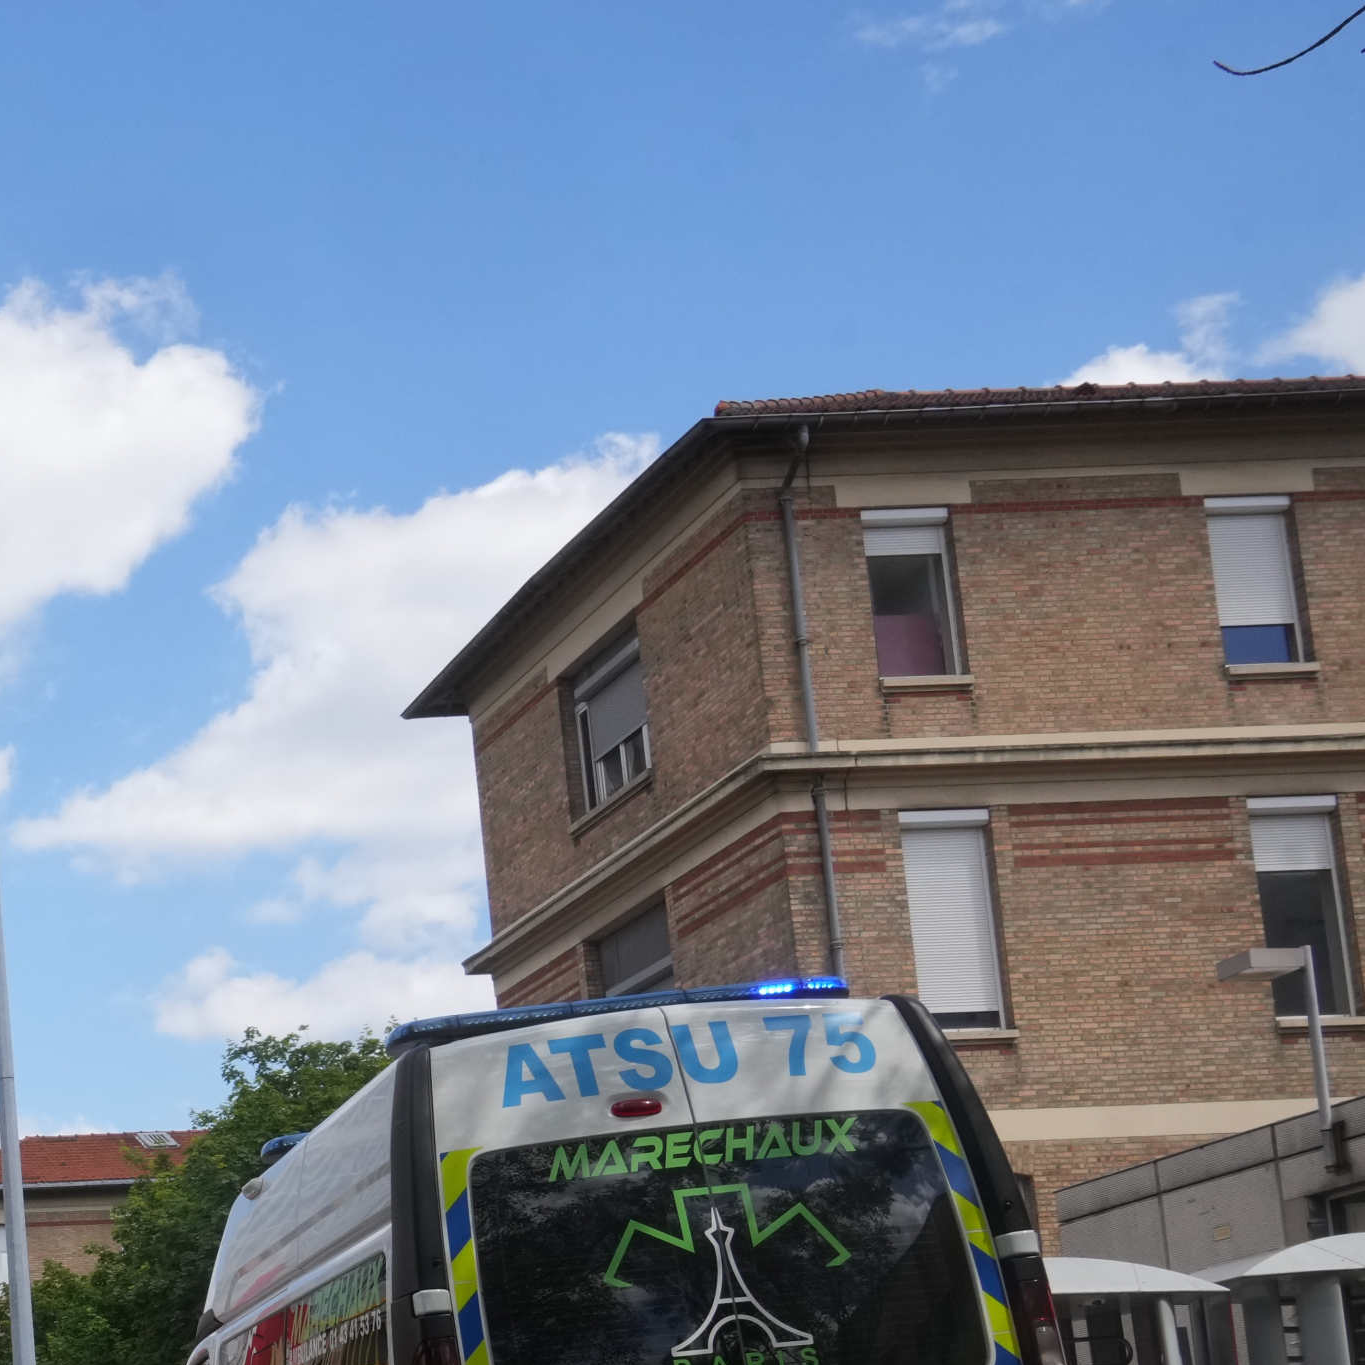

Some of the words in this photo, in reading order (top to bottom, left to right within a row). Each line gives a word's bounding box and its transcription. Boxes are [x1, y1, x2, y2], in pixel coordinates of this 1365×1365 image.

[502, 1020, 739, 1108] ATSU
[763, 1012, 876, 1077] 75
[548, 1116, 859, 1182] MARECHAUX
